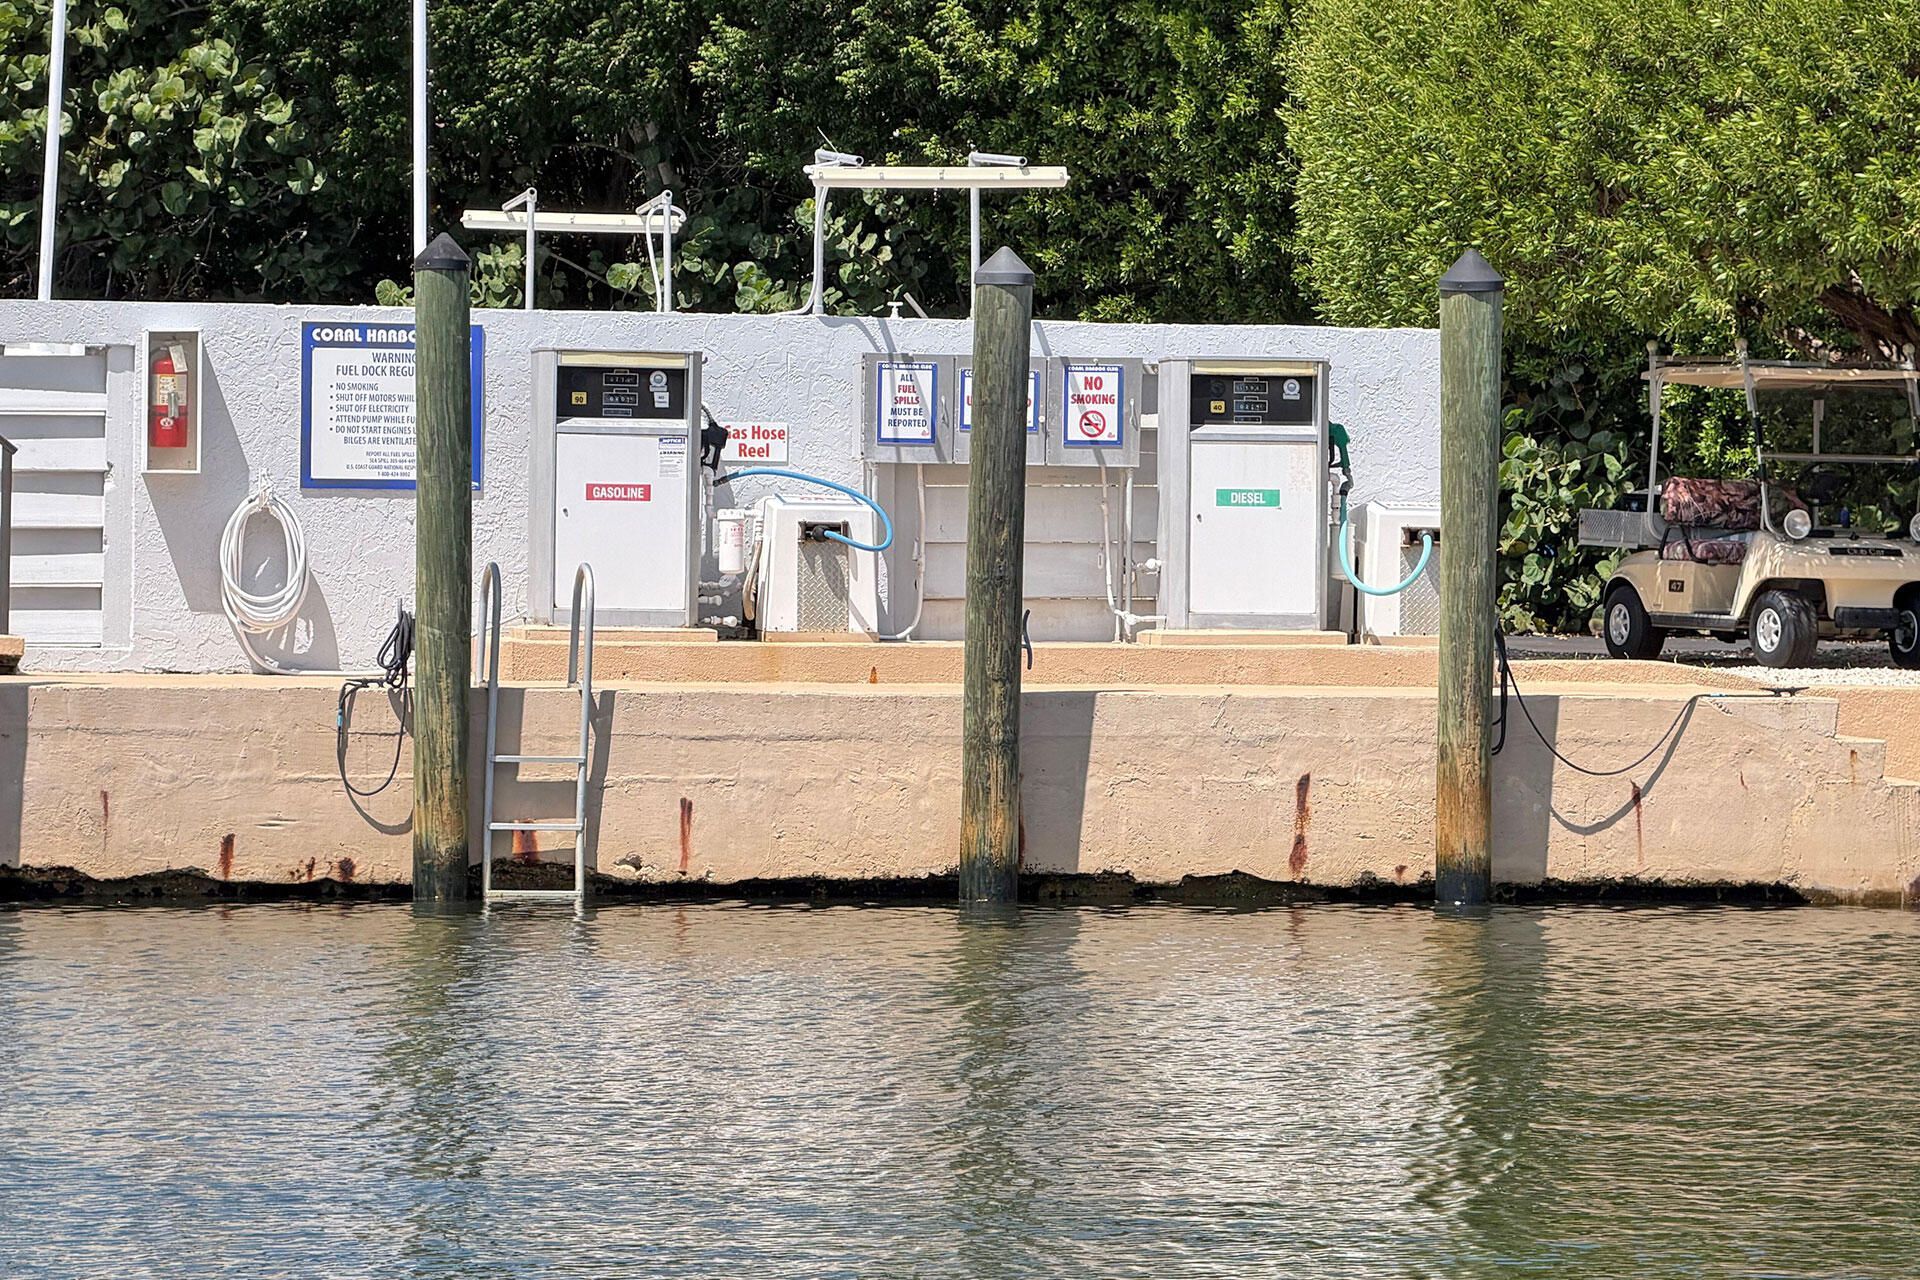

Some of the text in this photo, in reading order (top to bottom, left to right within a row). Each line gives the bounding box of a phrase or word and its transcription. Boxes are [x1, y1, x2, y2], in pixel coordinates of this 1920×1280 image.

[312, 328, 416, 343] CORAL HARBO
[336, 365, 359, 376] FUEL
[361, 366, 387, 377] DOCK
[900, 373, 915, 382] ALL
[335, 382, 379, 391] NO SMOKING
[1084, 376, 1104, 391] NO
[898, 384, 917, 394] FUEL
[335, 393, 415, 402] SHUT OFF MOTORS WHIL
[894, 396, 920, 405] SPILLS
[1070, 394, 1116, 405] SMOKING
[335, 404, 409, 413] SHUT OFF ELECTRICITY
[890, 407, 924, 416] MUST BE
[335, 415, 361, 423] ATTEND
[362, 415, 382, 423] PUMP
[383, 415, 405, 424] WHILE
[888, 418, 928, 428] REPORTED
[335, 425, 345, 434] DO
[346, 425, 360, 434] NOT
[361, 426, 381, 434] START
[382, 426, 412, 435] ENGINES
[751, 425, 786, 440] Hose
[343, 436, 416, 446] BILGES ARE VENTILATE
[738, 443, 770, 457] Reel
[592, 486, 645, 499] GASOLINE
[1231, 492, 1266, 504] DIESEL
